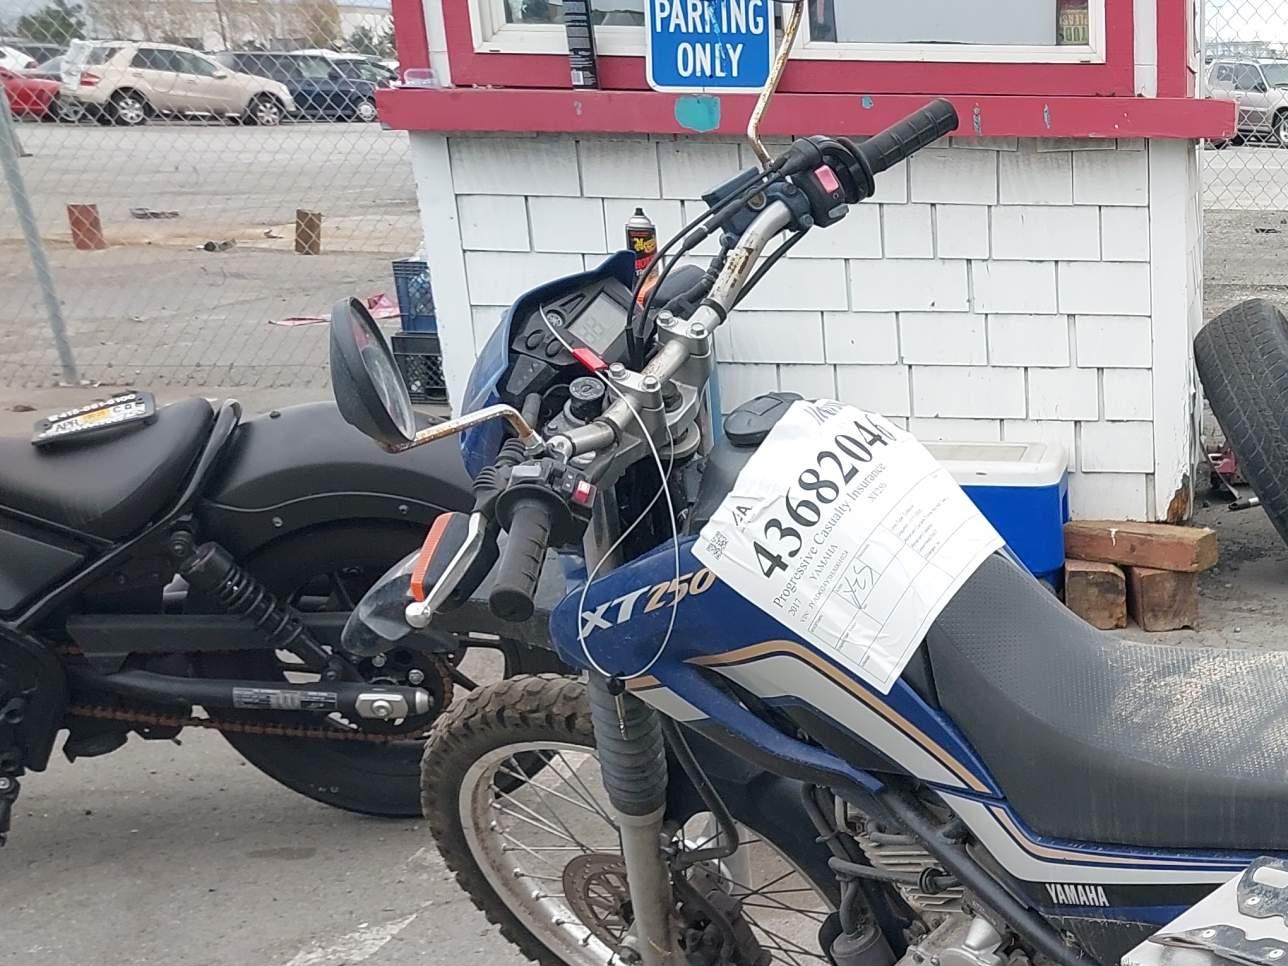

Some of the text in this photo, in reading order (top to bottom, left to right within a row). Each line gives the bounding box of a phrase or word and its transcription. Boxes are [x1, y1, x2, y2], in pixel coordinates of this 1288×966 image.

[655, 0, 765, 35] PARKING
[677, 42, 744, 78] ONLY
[753, 414, 897, 579] 43682046
[773, 462, 887, 609] Progressive Casualty Insurance
[787, 598, 802, 617] 2017
[809, 543, 839, 582] YAMAHA
[1045, 883, 1110, 907] YAMAHA
